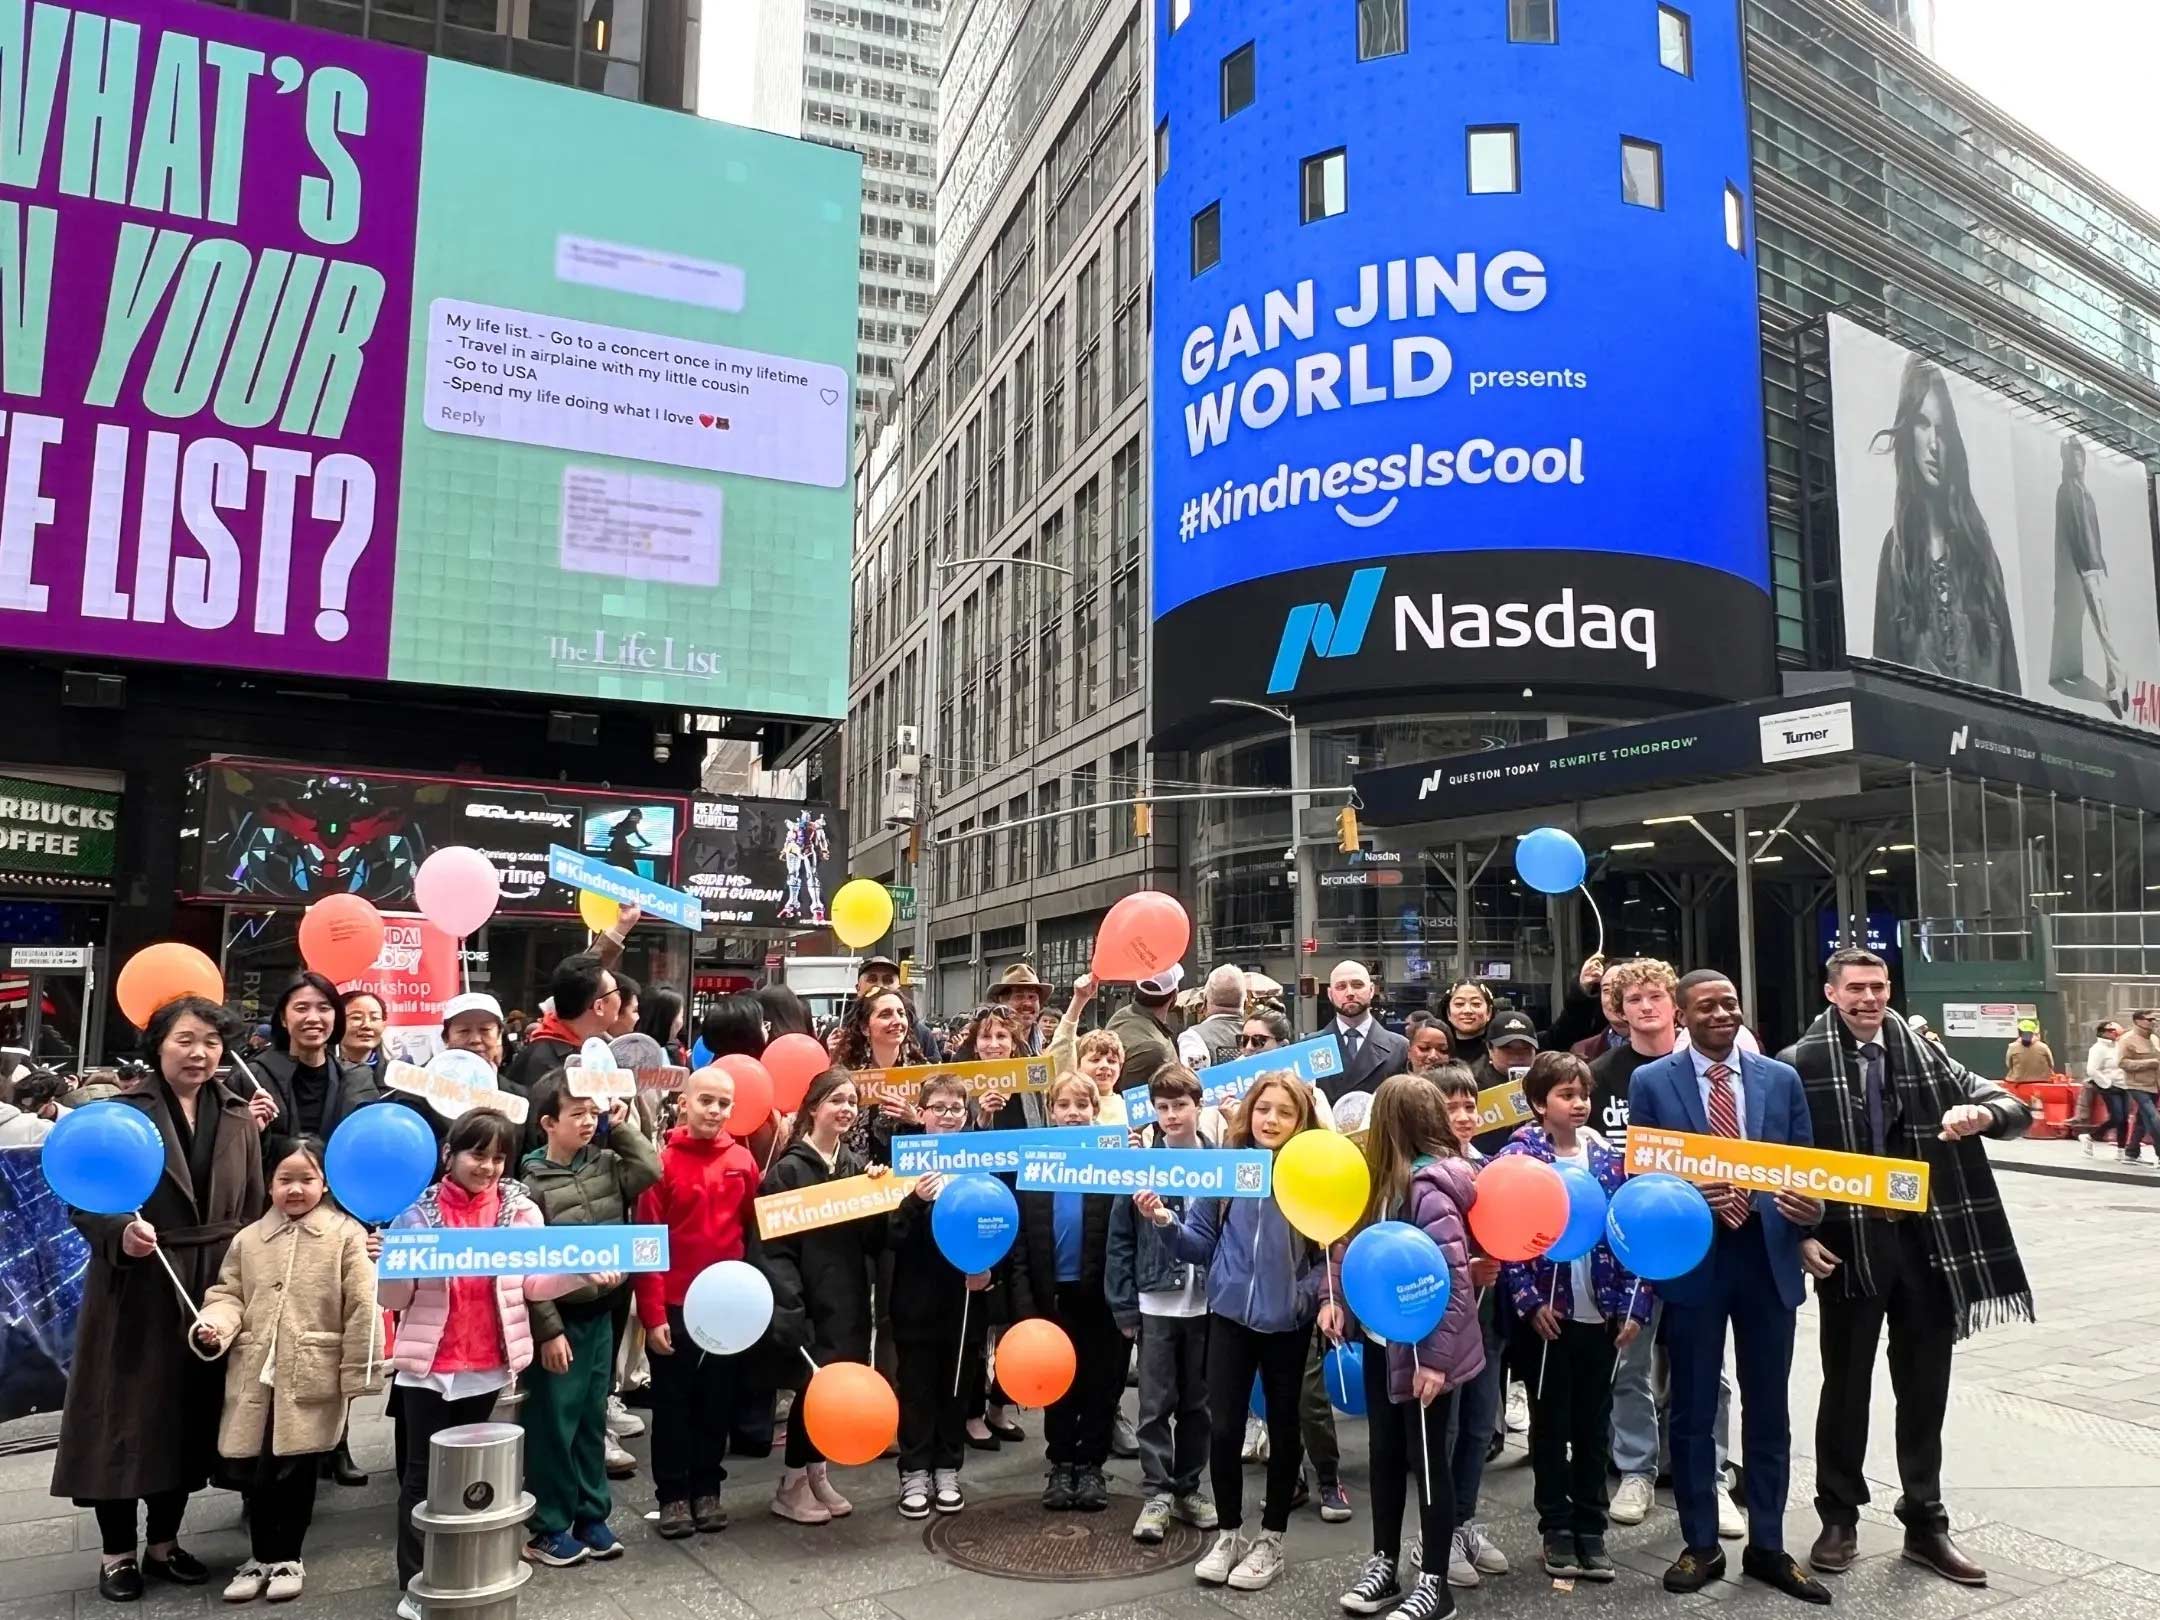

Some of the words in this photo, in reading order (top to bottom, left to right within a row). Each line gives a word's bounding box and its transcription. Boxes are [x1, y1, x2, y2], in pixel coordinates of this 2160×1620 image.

[83, 221, 386, 440] YOUR
[1181, 279, 1314, 386] GAN
[1334, 250, 1547, 328] JING
[447, 313, 471, 331] My
[476, 318, 500, 335] life
[550, 331, 573, 347] Go
[577, 336, 593, 350] to
[597, 341, 606, 352] a
[611, 342, 670, 362] concert
[674, 353, 710, 369] once
[714, 356, 727, 371] in
[731, 362, 753, 378] my
[756, 366, 809, 386] lifetime
[458, 336, 507, 355] Travel
[512, 344, 525, 359] in
[601, 358, 633, 376] with
[639, 366, 660, 382] my
[665, 368, 697, 386] little
[702, 375, 750, 395] cousin
[482, 360, 498, 374] to
[503, 364, 538, 380] USA
[508, 387, 532, 403] my
[537, 388, 561, 405] life
[565, 393, 609, 414] doing
[613, 401, 651, 418] what
[663, 409, 694, 426] love
[1184, 335, 1453, 457] WORLD
[1469, 367, 1587, 395] presents
[441, 407, 485, 427] Reply
[1179, 437, 1585, 543] #KindnessIsCool
[81, 422, 376, 642] LIST?
[1394, 587, 1657, 670] Nasdaq
[545, 635, 587, 661] The
[591, 630, 656, 668] Life
[662, 637, 721, 675] List
[1782, 729, 1829, 745] Turner
[1449, 768, 1500, 785] QUESTION
[1505, 762, 1540, 777] TODAY
[1549, 751, 1607, 769] REWRITE
[498, 865, 546, 885] rime
[1365, 852, 1400, 862] Nasdaq
[729, 889, 784, 901] GUNDAM
[347, 979, 431, 998] Workshop
[899, 1149, 1020, 1171] #Kindness
[1024, 1162, 1222, 1188] #KindnessIsCool
[1634, 1146, 1872, 1197] #KindnessIsCool
[385, 1244, 620, 1271] #KindnessIsCool
